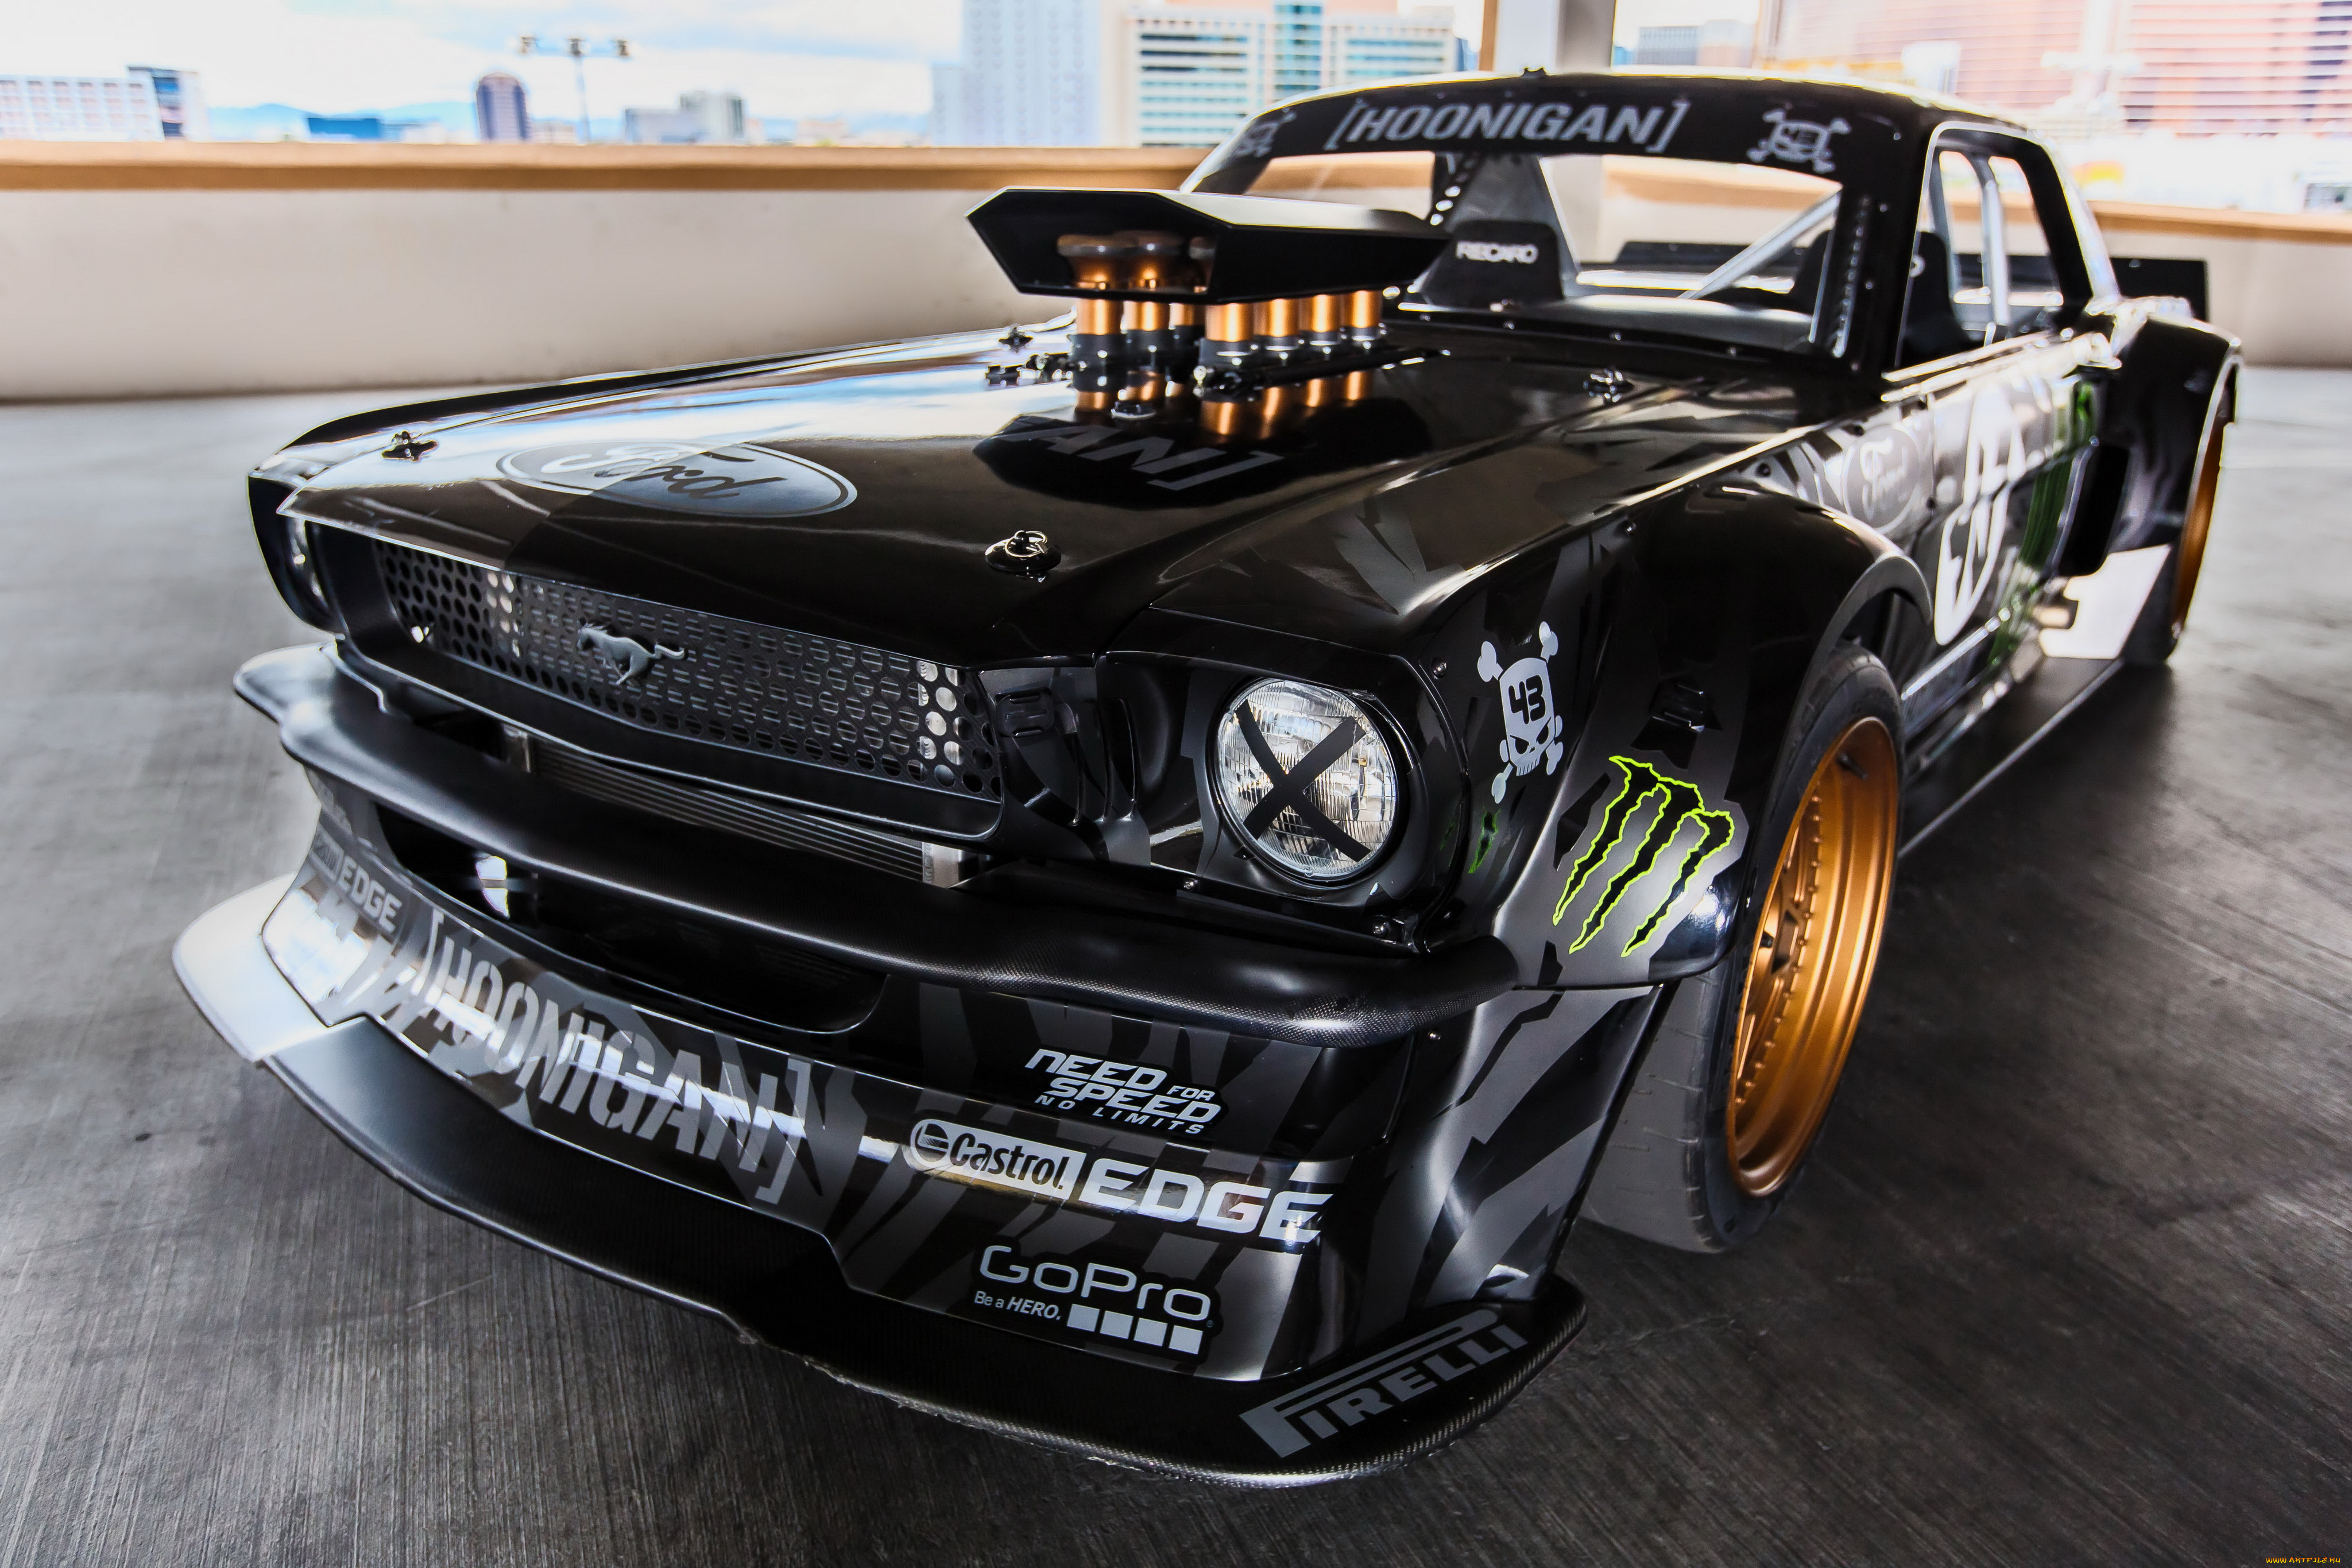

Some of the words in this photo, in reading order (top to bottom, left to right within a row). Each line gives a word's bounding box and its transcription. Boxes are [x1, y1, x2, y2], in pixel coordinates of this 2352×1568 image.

[1324, 99, 1690, 153] [HOONIGAN]
[541, 443, 788, 498] Ford
[1508, 674, 1548, 725] 43
[337, 857, 402, 934] EDGE
[1025, 1048, 1167, 1091] NEED
[1166, 1085, 1216, 1101] FOR
[1043, 1078, 1221, 1123] SPEED
[1034, 1095, 1075, 1110] NO
[1092, 1107, 1204, 1135] LIMITS
[950, 1132, 1070, 1190] Castrol
[1078, 1158, 1333, 1243] EDGE
[974, 1291, 992, 1306] Be
[995, 1298, 1004, 1308] a
[1007, 1296, 1063, 1321] HERO.
[980, 1245, 1211, 1321] GoPro
[1239, 1309, 1528, 1458] PIRELLI
